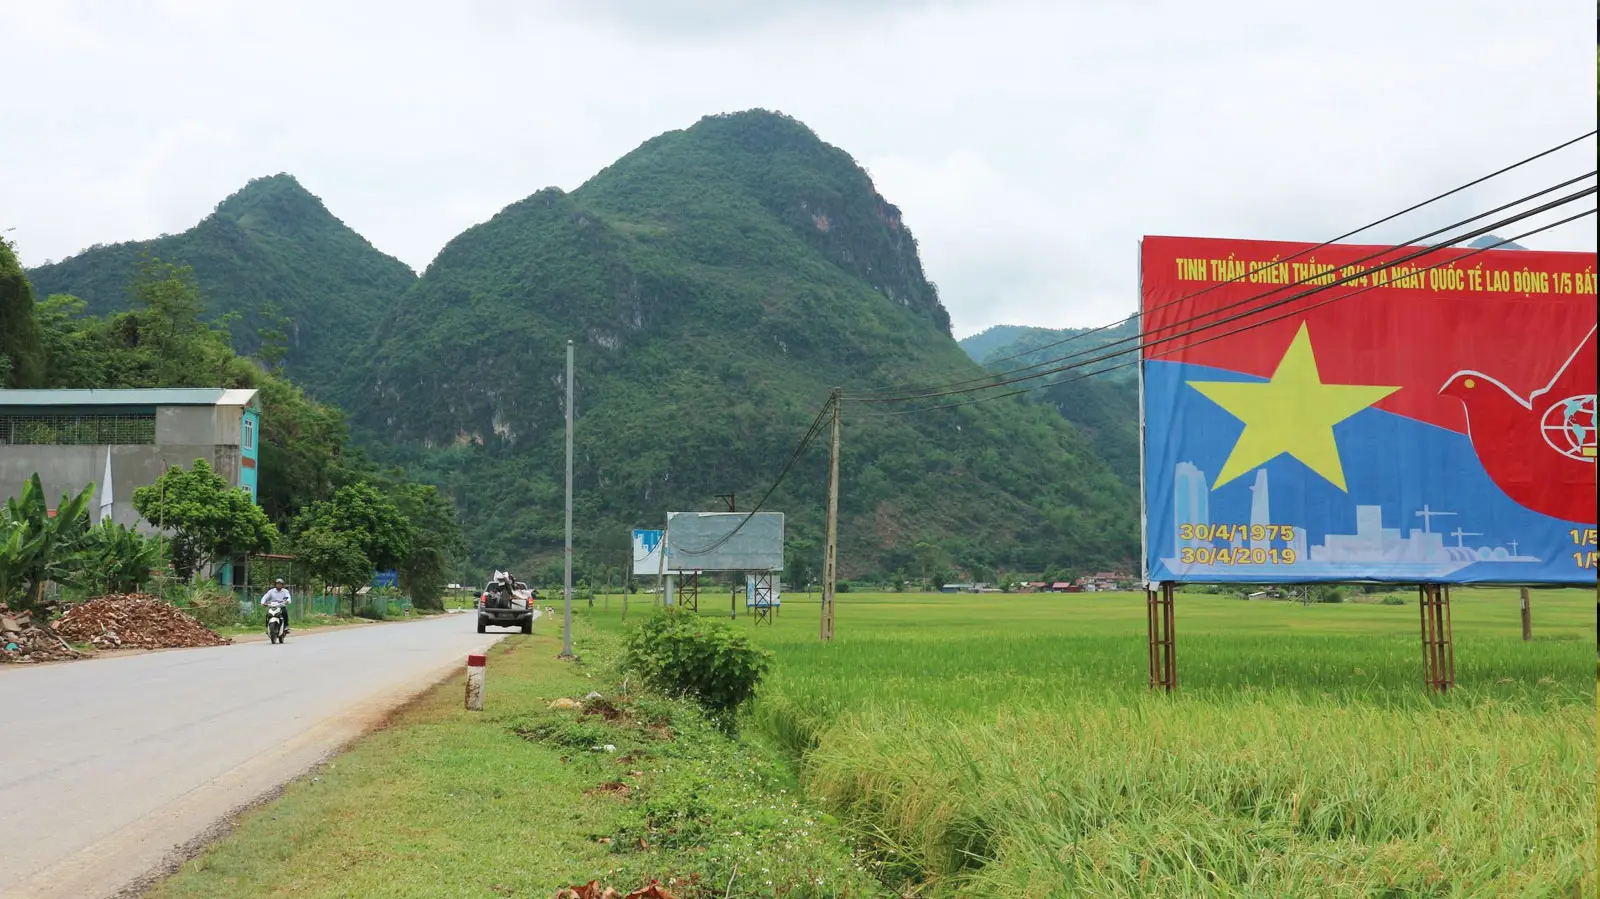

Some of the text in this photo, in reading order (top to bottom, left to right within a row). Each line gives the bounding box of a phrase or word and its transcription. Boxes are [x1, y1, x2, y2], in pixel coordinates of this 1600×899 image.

[1176, 258, 1207, 281] TINH
[1210, 252, 1246, 283] THẦN
[1249, 254, 1289, 285] CHIẾN
[1293, 256, 1336, 286] THẮNG
[1339, 264, 1367, 287] 30/4
[1371, 262, 1388, 288] VÀ
[1391, 263, 1426, 289] NGÀY
[1430, 261, 1465, 292] QUỐC
[1467, 262, 1483, 292] TẾ
[1486, 269, 1510, 292] LAO
[1513, 267, 1550, 298] ĐỘNG
[1552, 274, 1573, 294] 1/5
[1180, 523, 1295, 542] 30/4/1975
[1181, 546, 1296, 566] 30/4/2019
